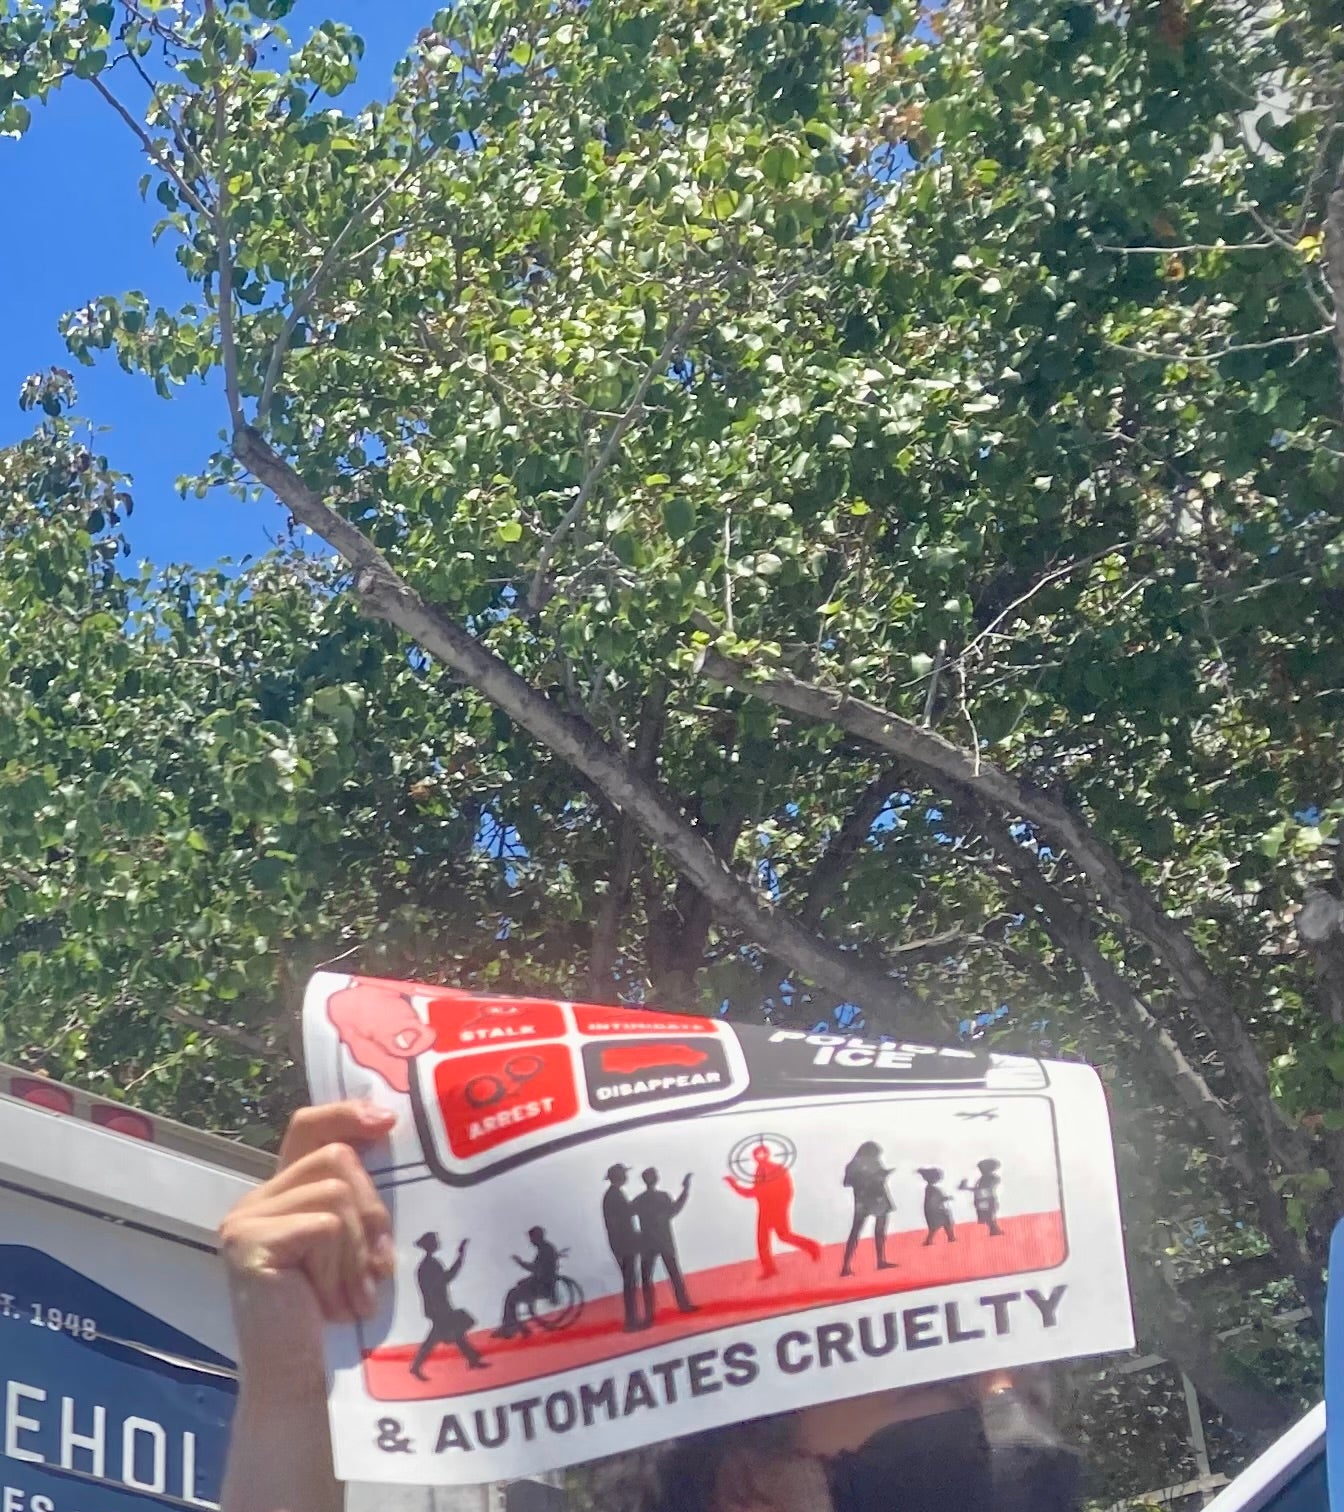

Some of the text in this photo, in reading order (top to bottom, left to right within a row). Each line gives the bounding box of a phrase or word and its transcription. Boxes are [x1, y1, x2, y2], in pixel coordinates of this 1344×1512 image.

[459, 1023, 536, 1042] STALK
[813, 1046, 916, 1069] ICE
[595, 1072, 721, 1101] DISAPPEAR
[468, 1097, 555, 1140] ARREST
[30, 1302, 99, 1342] 1948
[374, 1283, 1069, 1456] & AUTOMATES CRUELTY
